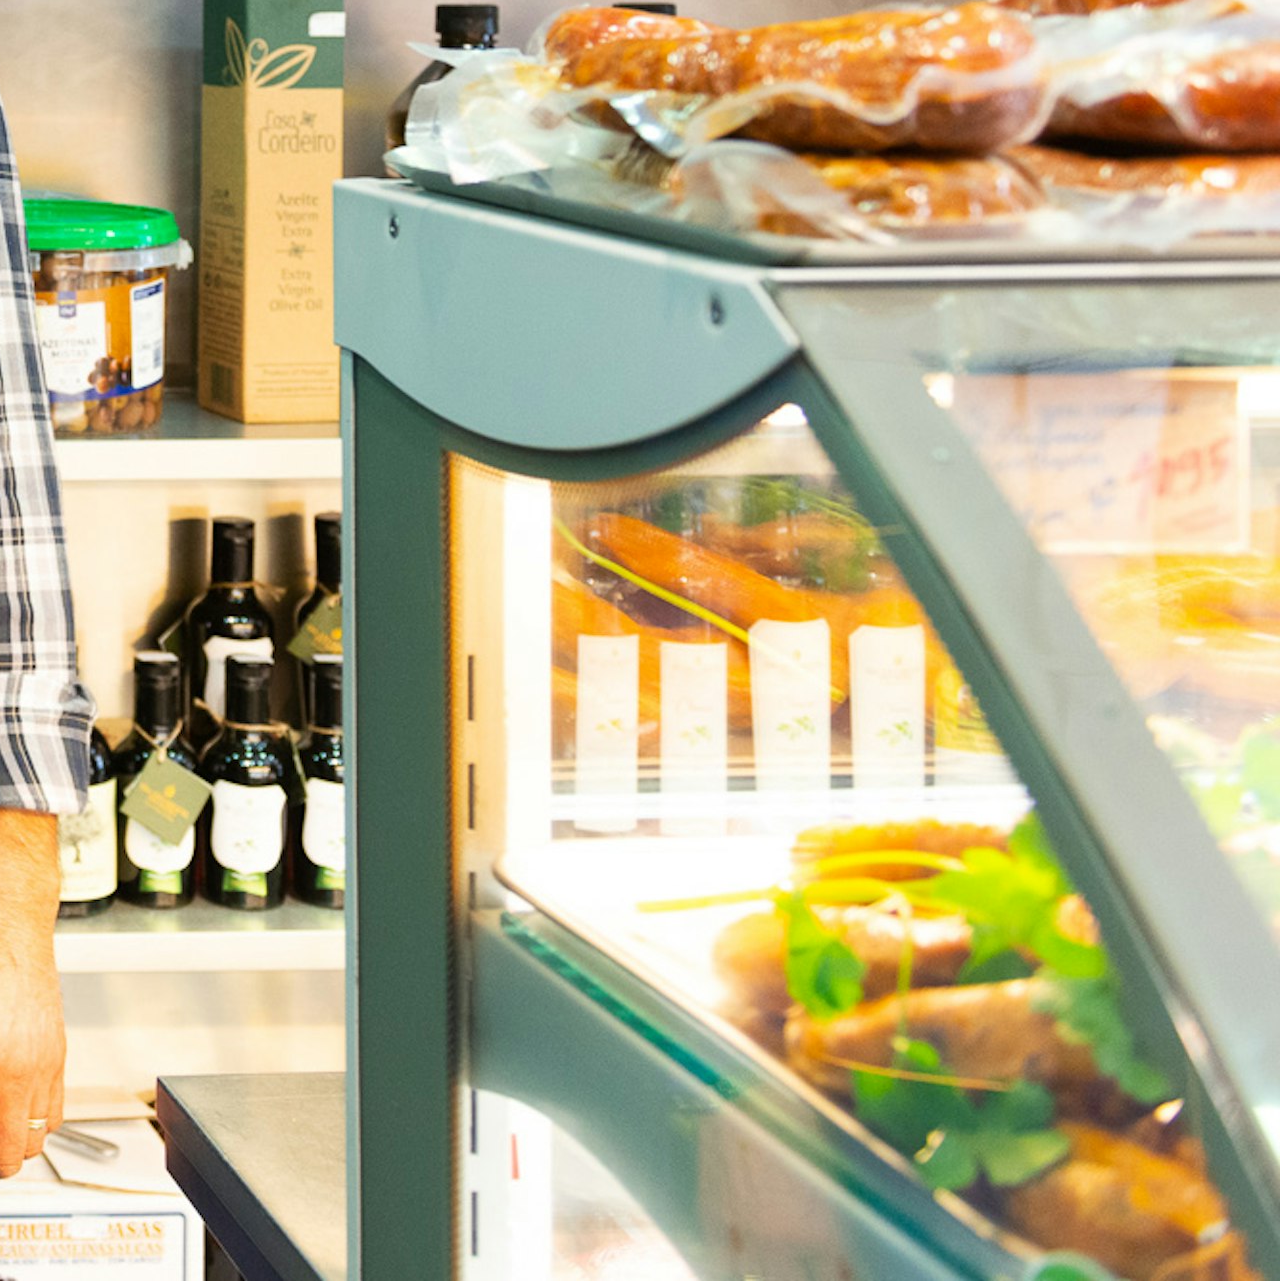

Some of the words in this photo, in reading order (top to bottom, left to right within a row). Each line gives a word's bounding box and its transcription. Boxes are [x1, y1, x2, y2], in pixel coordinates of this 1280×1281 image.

[258, 124, 336, 155] Cordeiro
[276, 193, 320, 207] Azeite
[274, 209, 320, 224] Virgem
[282, 225, 313, 238] Extra
[281, 269, 312, 282] Extra
[277, 283, 315, 299] Virgin
[269, 299, 303, 313] Olive
[305, 298, 324, 313] Oil
[42, 336, 97, 349] AZEITONAS
[51, 349, 89, 358] MISTAS
